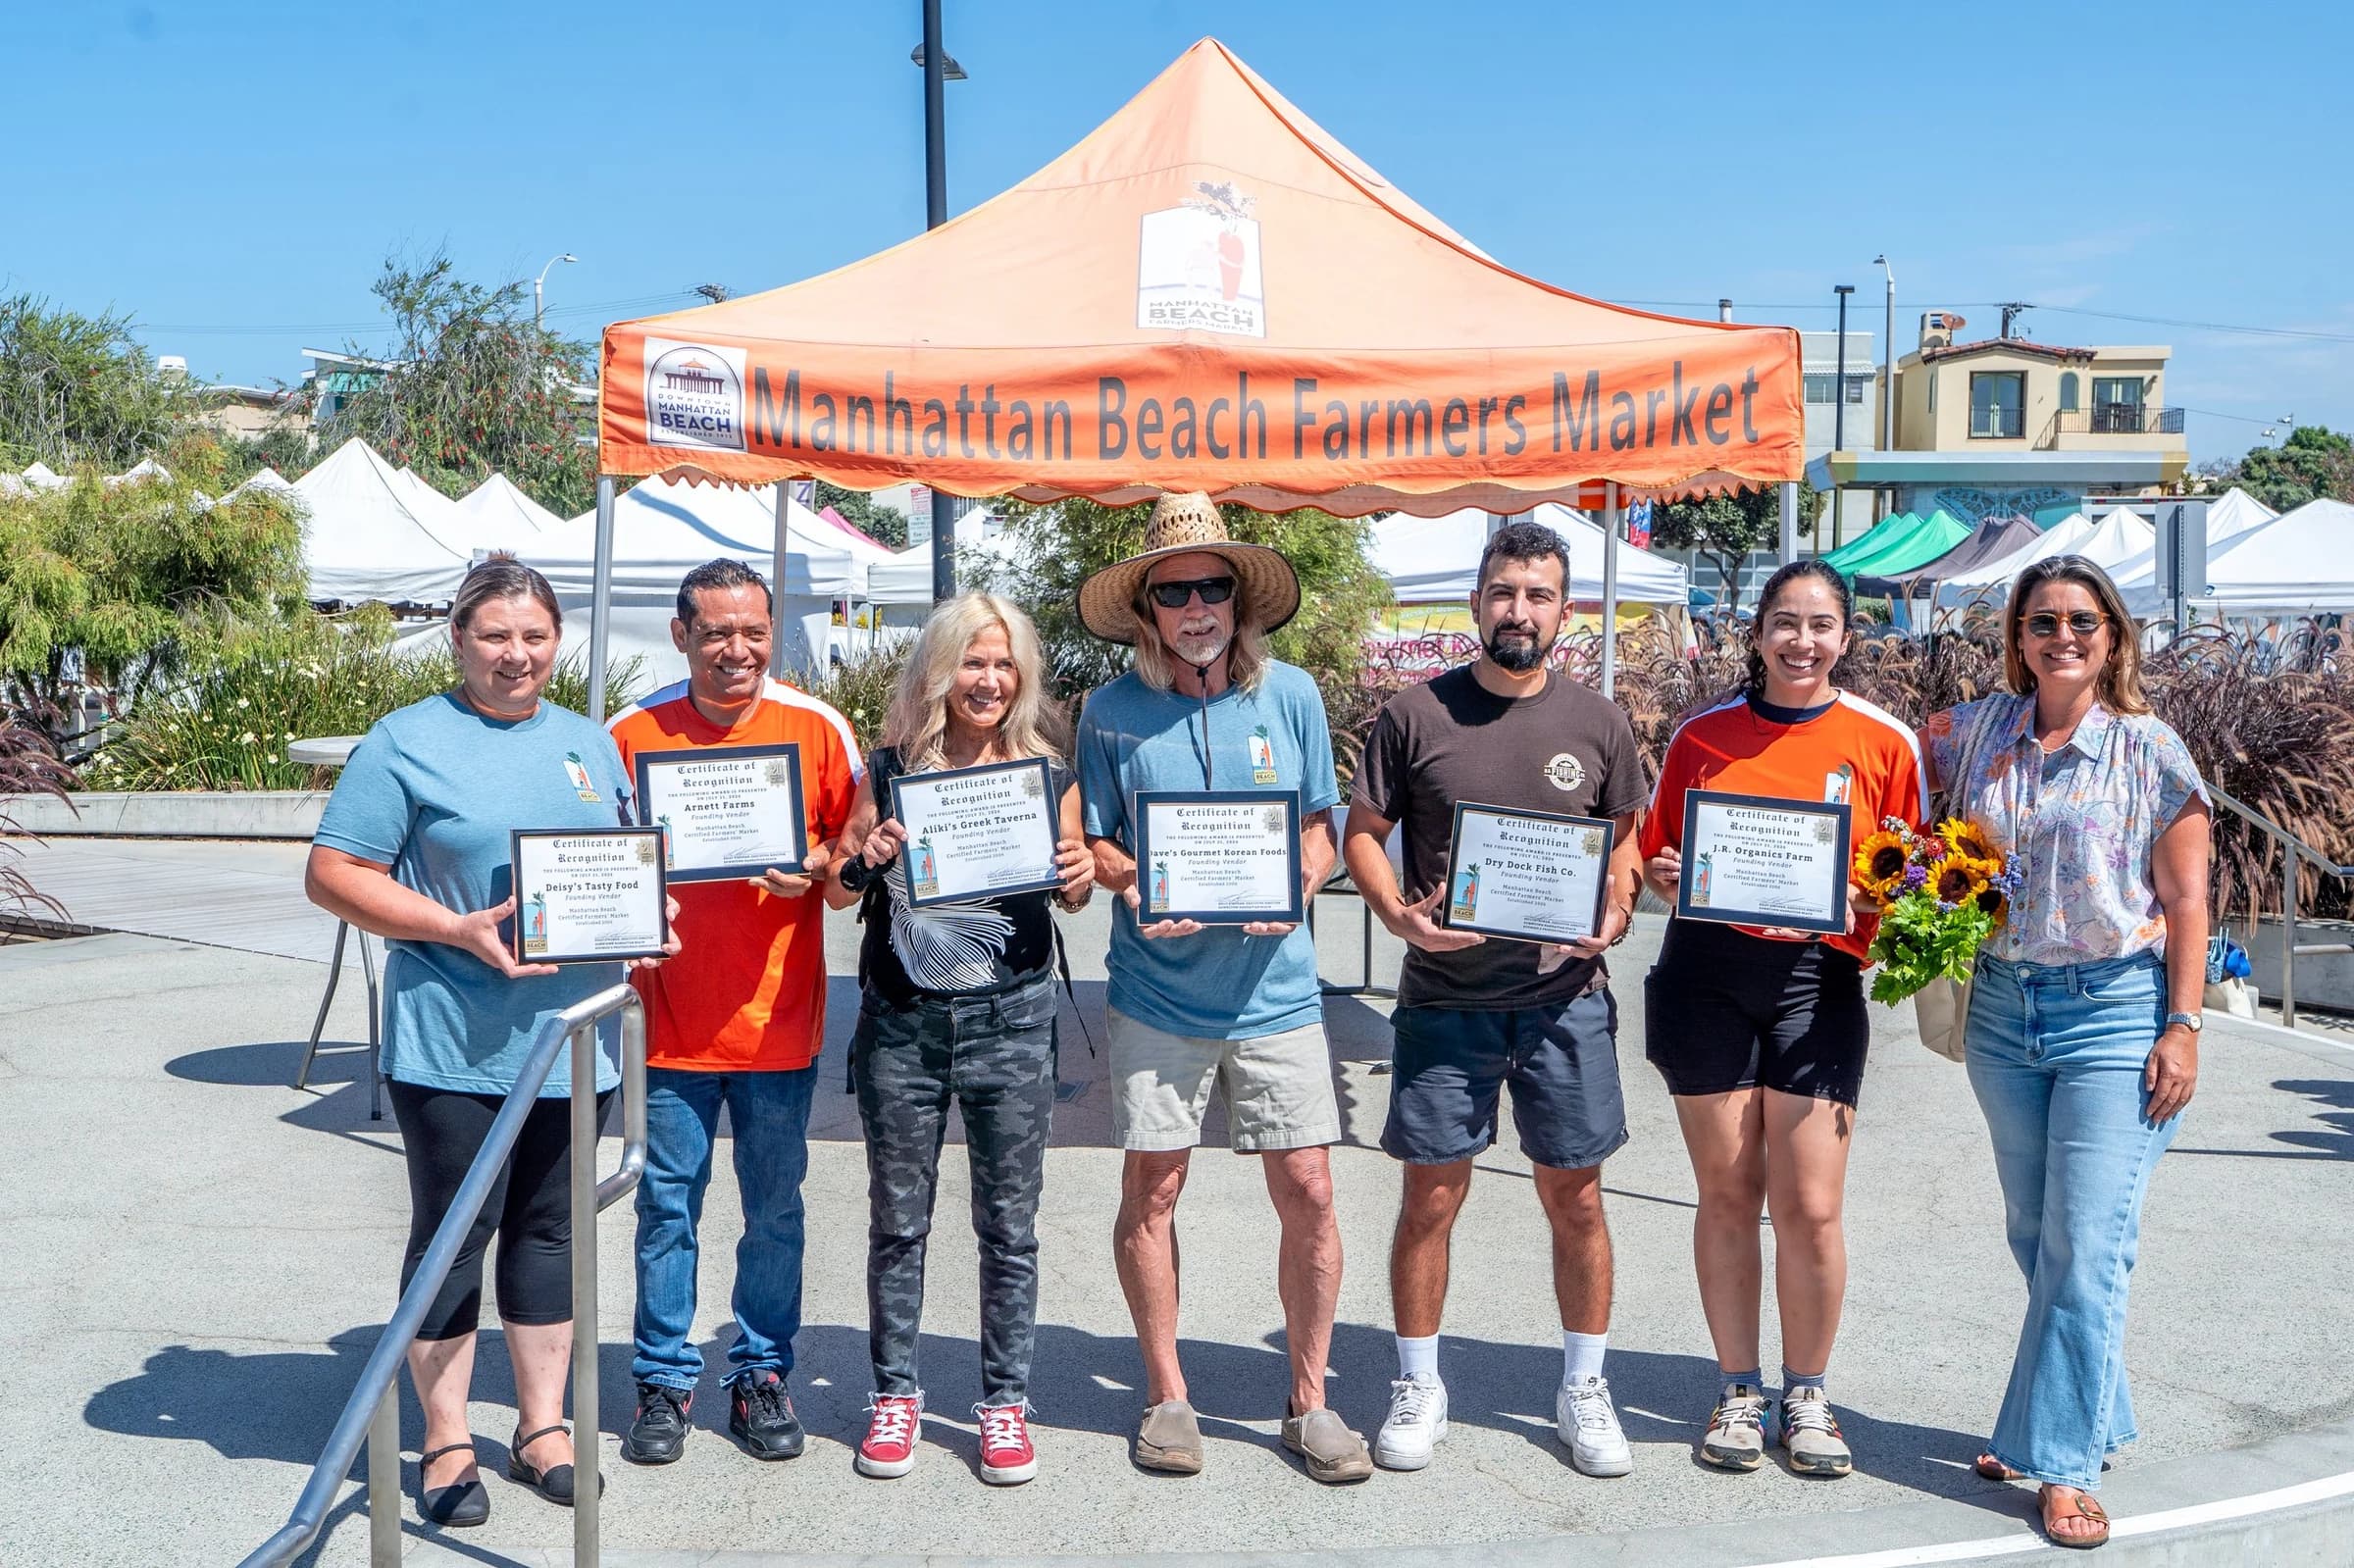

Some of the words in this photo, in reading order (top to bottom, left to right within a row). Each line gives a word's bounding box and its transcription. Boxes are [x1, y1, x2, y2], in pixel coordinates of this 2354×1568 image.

[1150, 300, 1253, 315] MANHATTAN
[1149, 308, 1254, 328] BEACH
[659, 394, 730, 406] DOWNTOWN
[659, 402, 730, 415] MANHATTAN
[754, 366, 1072, 461] Manhattan
[1099, 371, 1267, 460] Beach
[1294, 378, 1526, 460] Farmers
[1553, 360, 1759, 453] Market
[660, 413, 731, 432] BEACH
[678, 764, 738, 774] Certificate
[745, 761, 755, 769] of
[683, 777, 752, 787] Recognition
[935, 778, 995, 792] Certificate
[1001, 774, 1012, 783] of
[941, 791, 1010, 806] Recognition
[685, 803, 719, 811] Arnett
[1177, 808, 1237, 816] Certificate
[1727, 809, 1788, 821] Certificate
[922, 823, 957, 834] Aliki's
[961, 818, 991, 829] Greek
[994, 813, 1036, 824] Taverna
[1181, 822, 1250, 831] Recognition
[1497, 817, 1558, 832] Certificate
[1730, 822, 1799, 836] Recognition
[952, 831, 984, 840] Founding
[1500, 831, 1569, 848] Recognition
[553, 839, 611, 848] Certificate
[558, 853, 624, 863] Recognition
[1713, 845, 1731, 853] J.R.
[1735, 847, 1782, 858] Organics
[1786, 852, 1812, 861] Farm
[1485, 858, 1503, 868] Dry
[1507, 861, 1532, 870] Dock
[1536, 865, 1556, 874] Fish
[1561, 868, 1576, 876] Co.
[1733, 857, 1765, 866] Founding
[1501, 872, 1532, 881] Founding
[546, 883, 581, 892] Deisy's
[616, 881, 638, 889] Food
